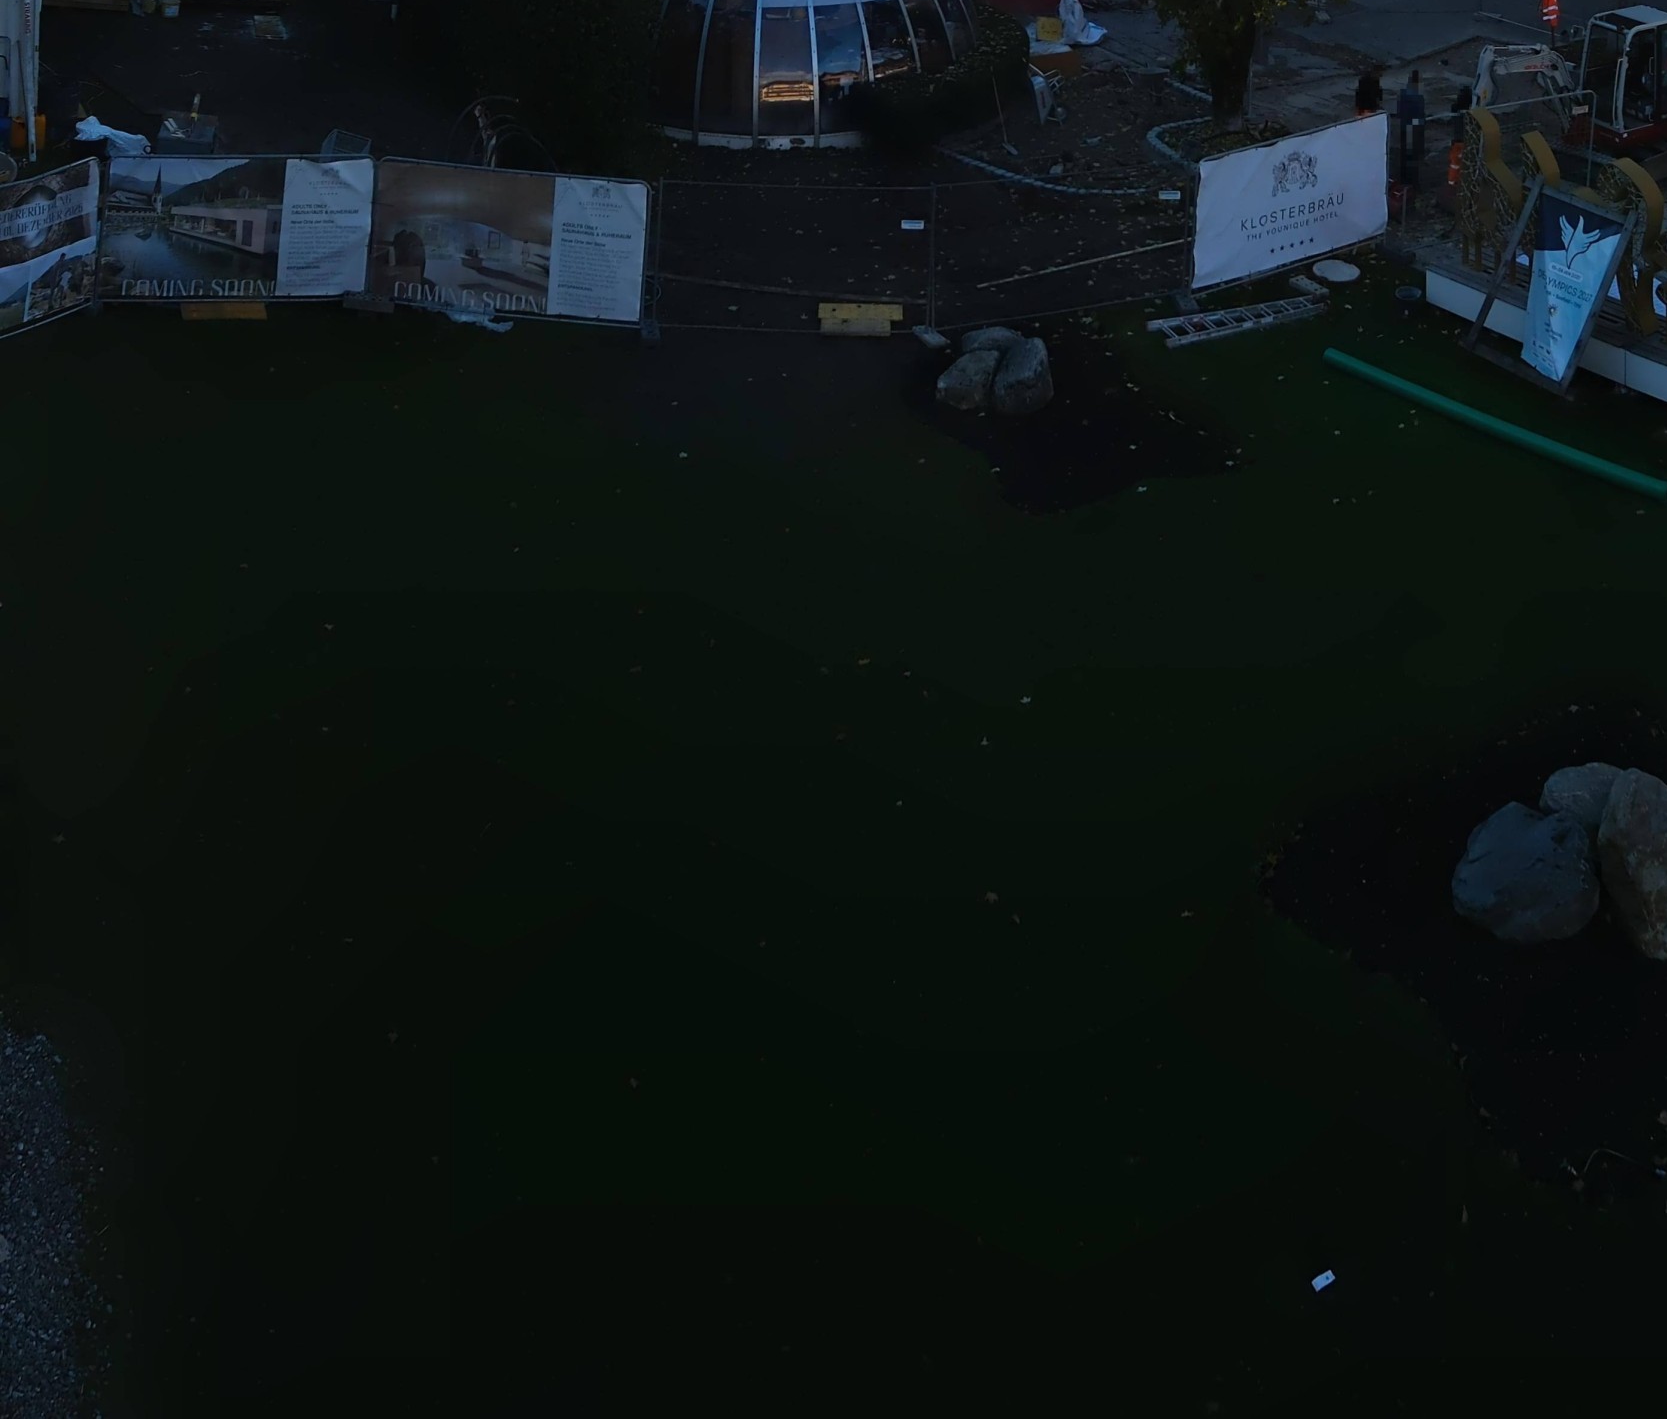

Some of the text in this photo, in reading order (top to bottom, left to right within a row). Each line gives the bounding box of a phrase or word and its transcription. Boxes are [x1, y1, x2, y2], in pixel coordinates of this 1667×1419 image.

[1240, 193, 1344, 231] KLOSTERBRÄU
[1246, 211, 1339, 241] THE YOUNIQUE HOTEL
[121, 279, 203, 297] COMING
[394, 280, 477, 309] COMING
